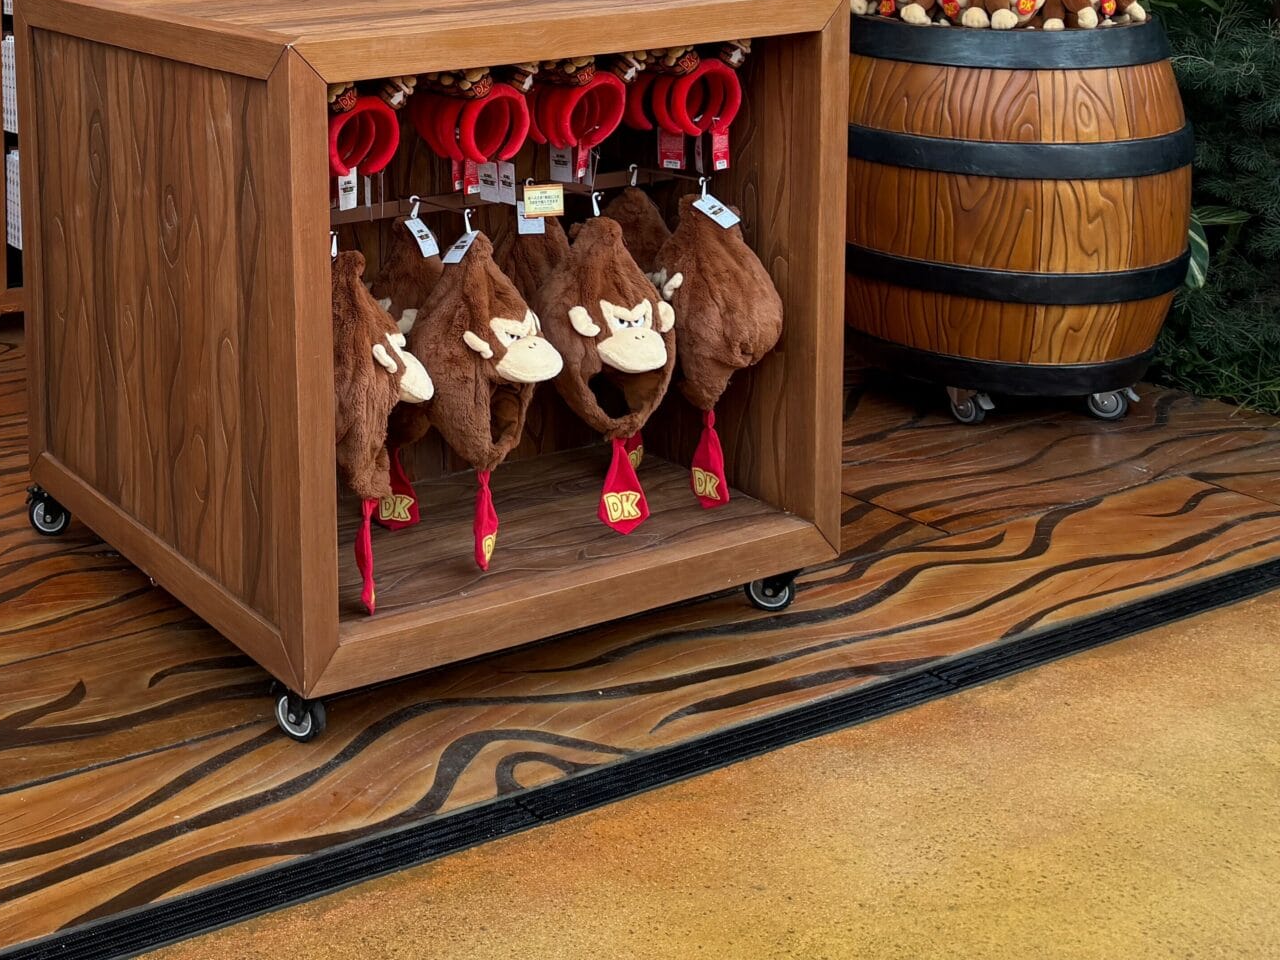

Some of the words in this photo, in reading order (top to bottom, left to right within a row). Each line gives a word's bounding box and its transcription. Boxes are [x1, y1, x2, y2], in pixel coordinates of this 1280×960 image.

[471, 76, 492, 97] DK
[337, 89, 358, 112] DK
[691, 467, 721, 500] DK
[380, 495, 414, 521] DK
[604, 491, 641, 522] DK
[482, 534, 498, 563] D
